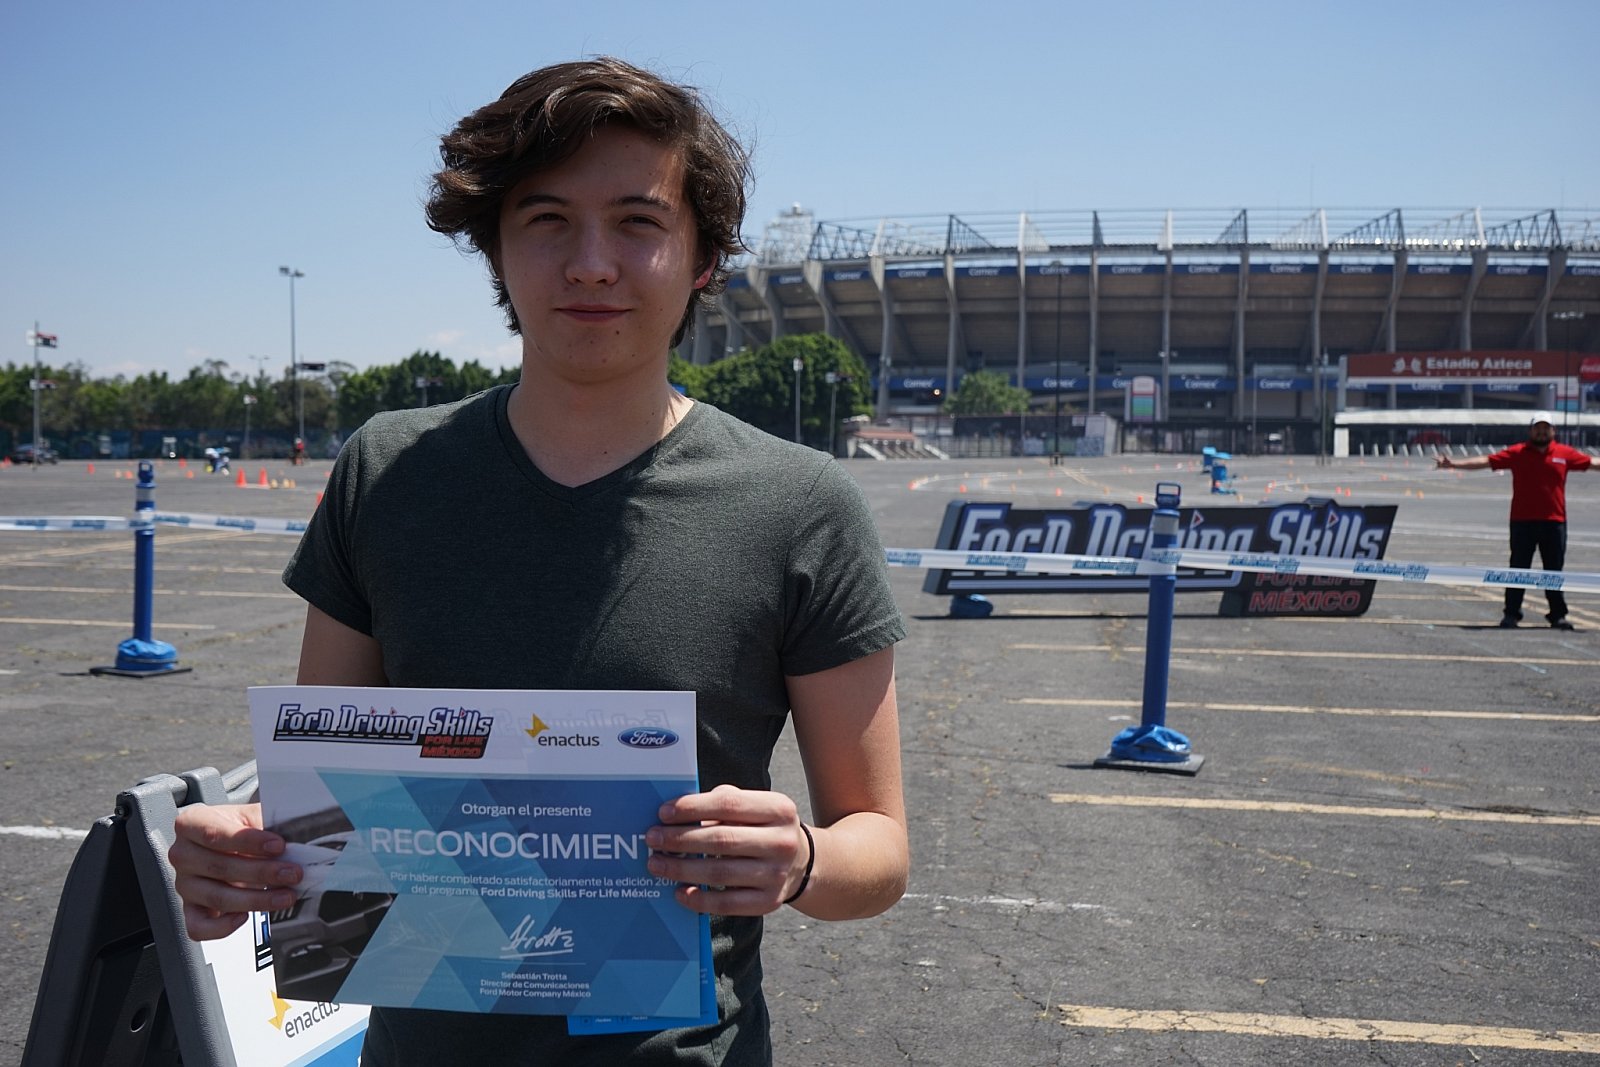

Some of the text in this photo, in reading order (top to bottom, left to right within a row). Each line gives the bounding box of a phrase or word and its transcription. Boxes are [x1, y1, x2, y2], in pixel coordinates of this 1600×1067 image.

[1426, 357, 1533, 371] Estadio Azteca
[1268, 509, 1385, 562] Skills
[1249, 587, 1361, 612] MÉXICO
[337, 704, 424, 745] Driving
[425, 707, 494, 737] Skills
[538, 733, 601, 747] enactus
[630, 730, 666, 746] Ford
[461, 802, 515, 816] Otorgan
[518, 803, 530, 815] el
[533, 805, 592, 818] presente
[370, 826, 687, 860] RECONOCIMIEN
[390, 871, 408, 881] Por
[409, 872, 439, 884] haber
[440, 874, 502, 886] completado
[504, 876, 602, 888] satisfactoriamente
[603, 877, 613, 886] la
[615, 877, 653, 887] edición
[411, 884, 660, 900] del programa Ford Driving Skills For Life México
[480, 979, 590, 990] Director de Comunicaciones
[501, 972, 568, 981] Sebastián Trotta
[479, 988, 592, 999] Ford Motor Company México
[284, 1001, 341, 1039] enactus
